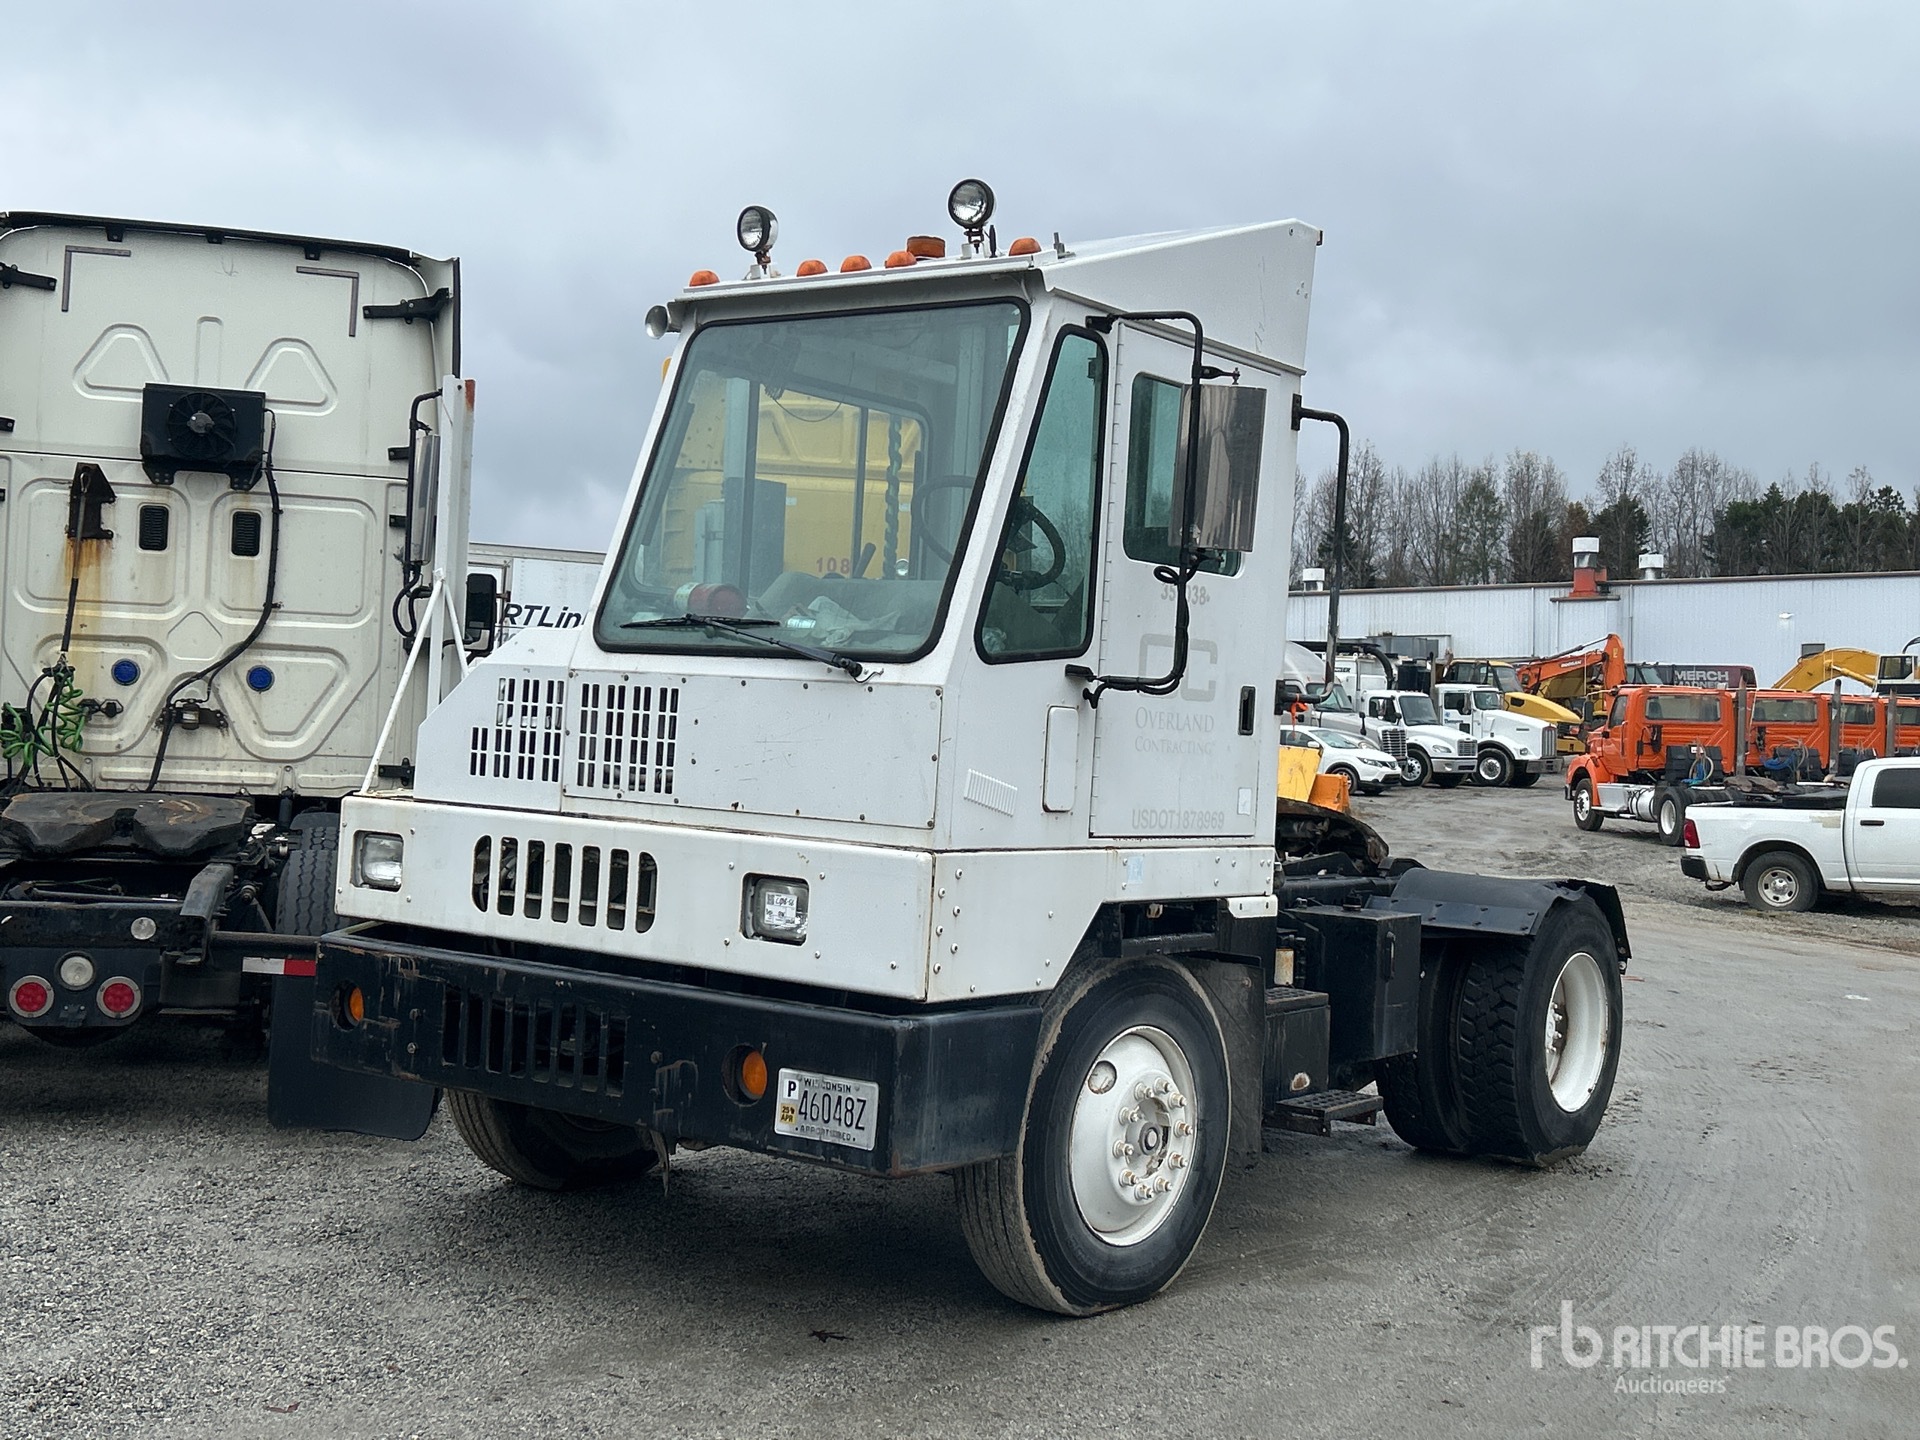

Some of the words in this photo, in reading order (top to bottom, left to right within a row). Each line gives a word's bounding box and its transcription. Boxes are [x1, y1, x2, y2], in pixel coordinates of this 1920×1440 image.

[503, 603, 587, 629] RTLin
[1674, 670, 1729, 681] MERCH
[1135, 706, 1215, 733] OVERLAND
[787, 1080, 797, 1098] P
[803, 1077, 852, 1094] WIONSIN
[798, 1089, 867, 1131] 46048Z
